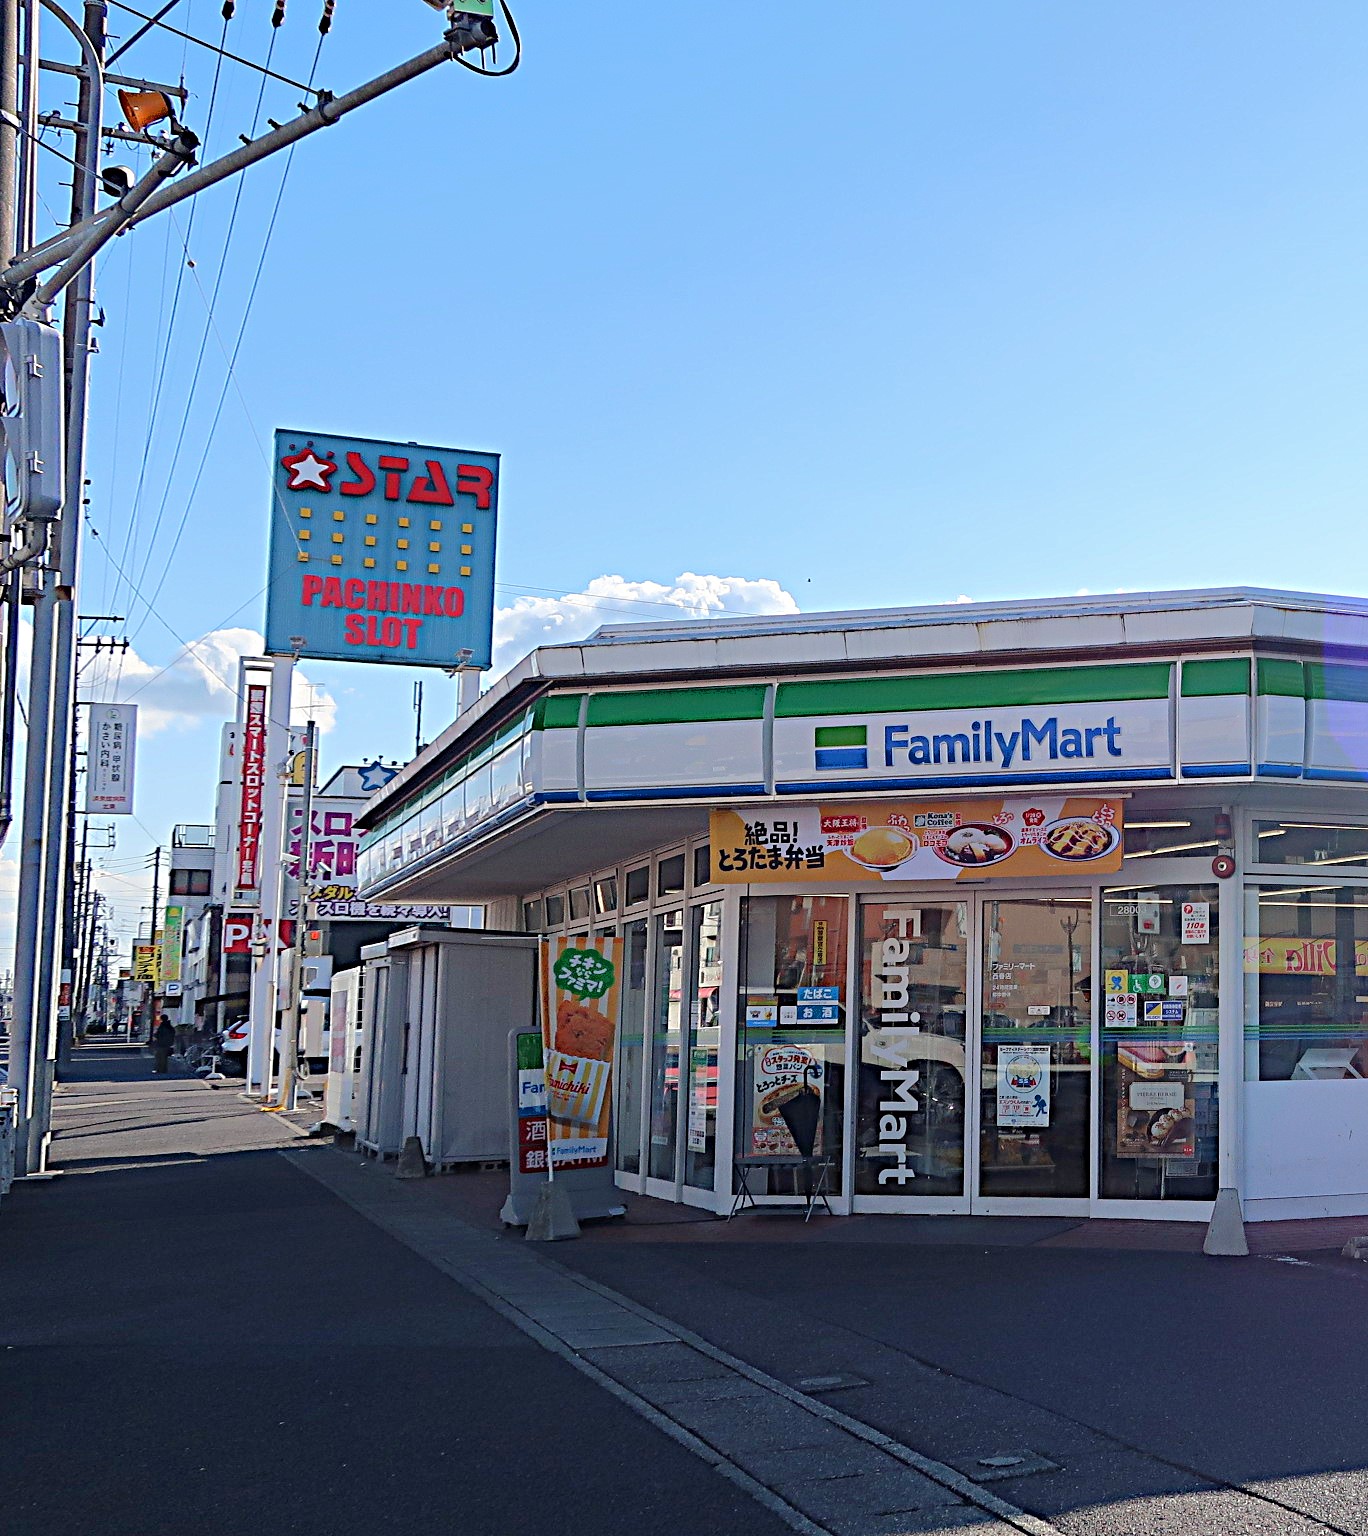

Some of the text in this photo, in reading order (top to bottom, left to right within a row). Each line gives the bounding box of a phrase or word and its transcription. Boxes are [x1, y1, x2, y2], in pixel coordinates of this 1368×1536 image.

[340, 451, 494, 510] STAR
[301, 574, 465, 618] PACHINKO
[344, 613, 423, 649] SLOT
[884, 716, 1122, 768] FamilyMart
[744, 821, 799, 846] 絶品!
[823, 819, 860, 829] 大阪王将
[826, 839, 855, 847] 天津炒飯
[1020, 837, 1049, 845] オムライス
[719, 844, 825, 872] とろたま弁当
[290, 900, 448, 918] ススロ機を続々導入!
[569, 954, 608, 976] チキン
[576, 966, 592, 979] なら
[992, 962, 1036, 971] ファミリーマート
[803, 988, 832, 999] たばこ
[870, 909, 922, 1185] FamilyMart
[756, 1074, 798, 1093] とろっとチーズ
[526, 1121, 546, 1140] 酒
[556, 1146, 597, 1156] FamilyMart
